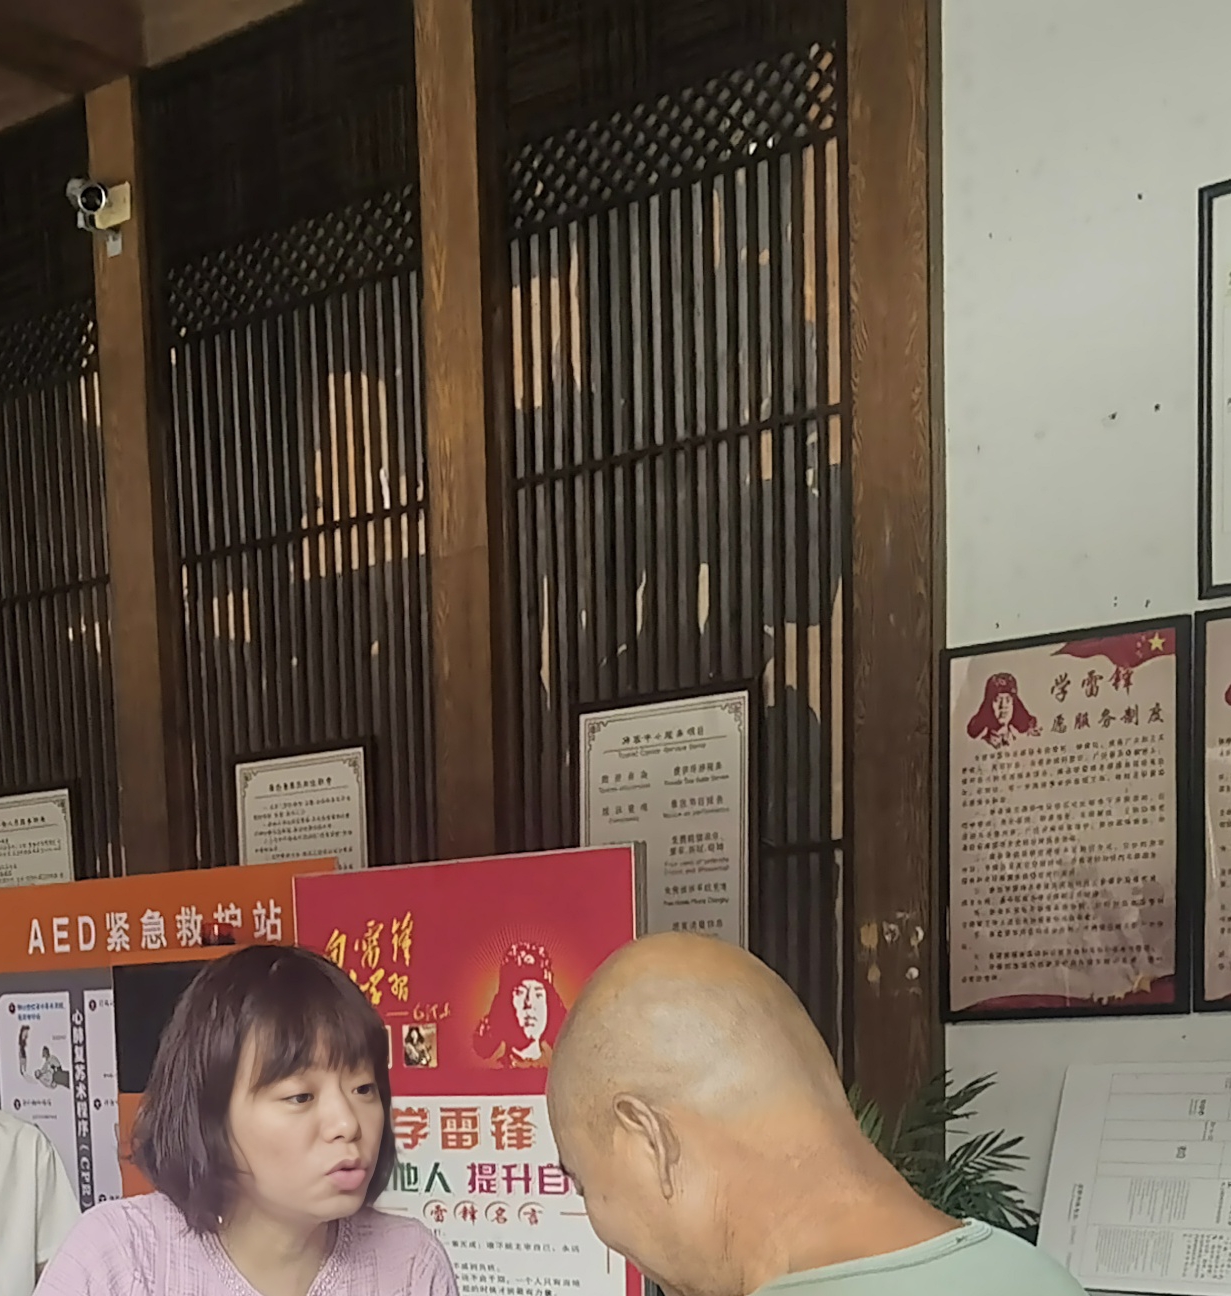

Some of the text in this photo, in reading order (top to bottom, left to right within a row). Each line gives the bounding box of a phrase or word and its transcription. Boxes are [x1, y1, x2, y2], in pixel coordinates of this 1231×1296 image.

[1051, 667, 1133, 702] 学雷锋
[28, 898, 282, 955] AED紧急救护站
[391, 1105, 538, 1151] 学雷锋
[467, 1162, 569, 1195] 提升自
[429, 1203, 544, 1226] 雷锋名言
